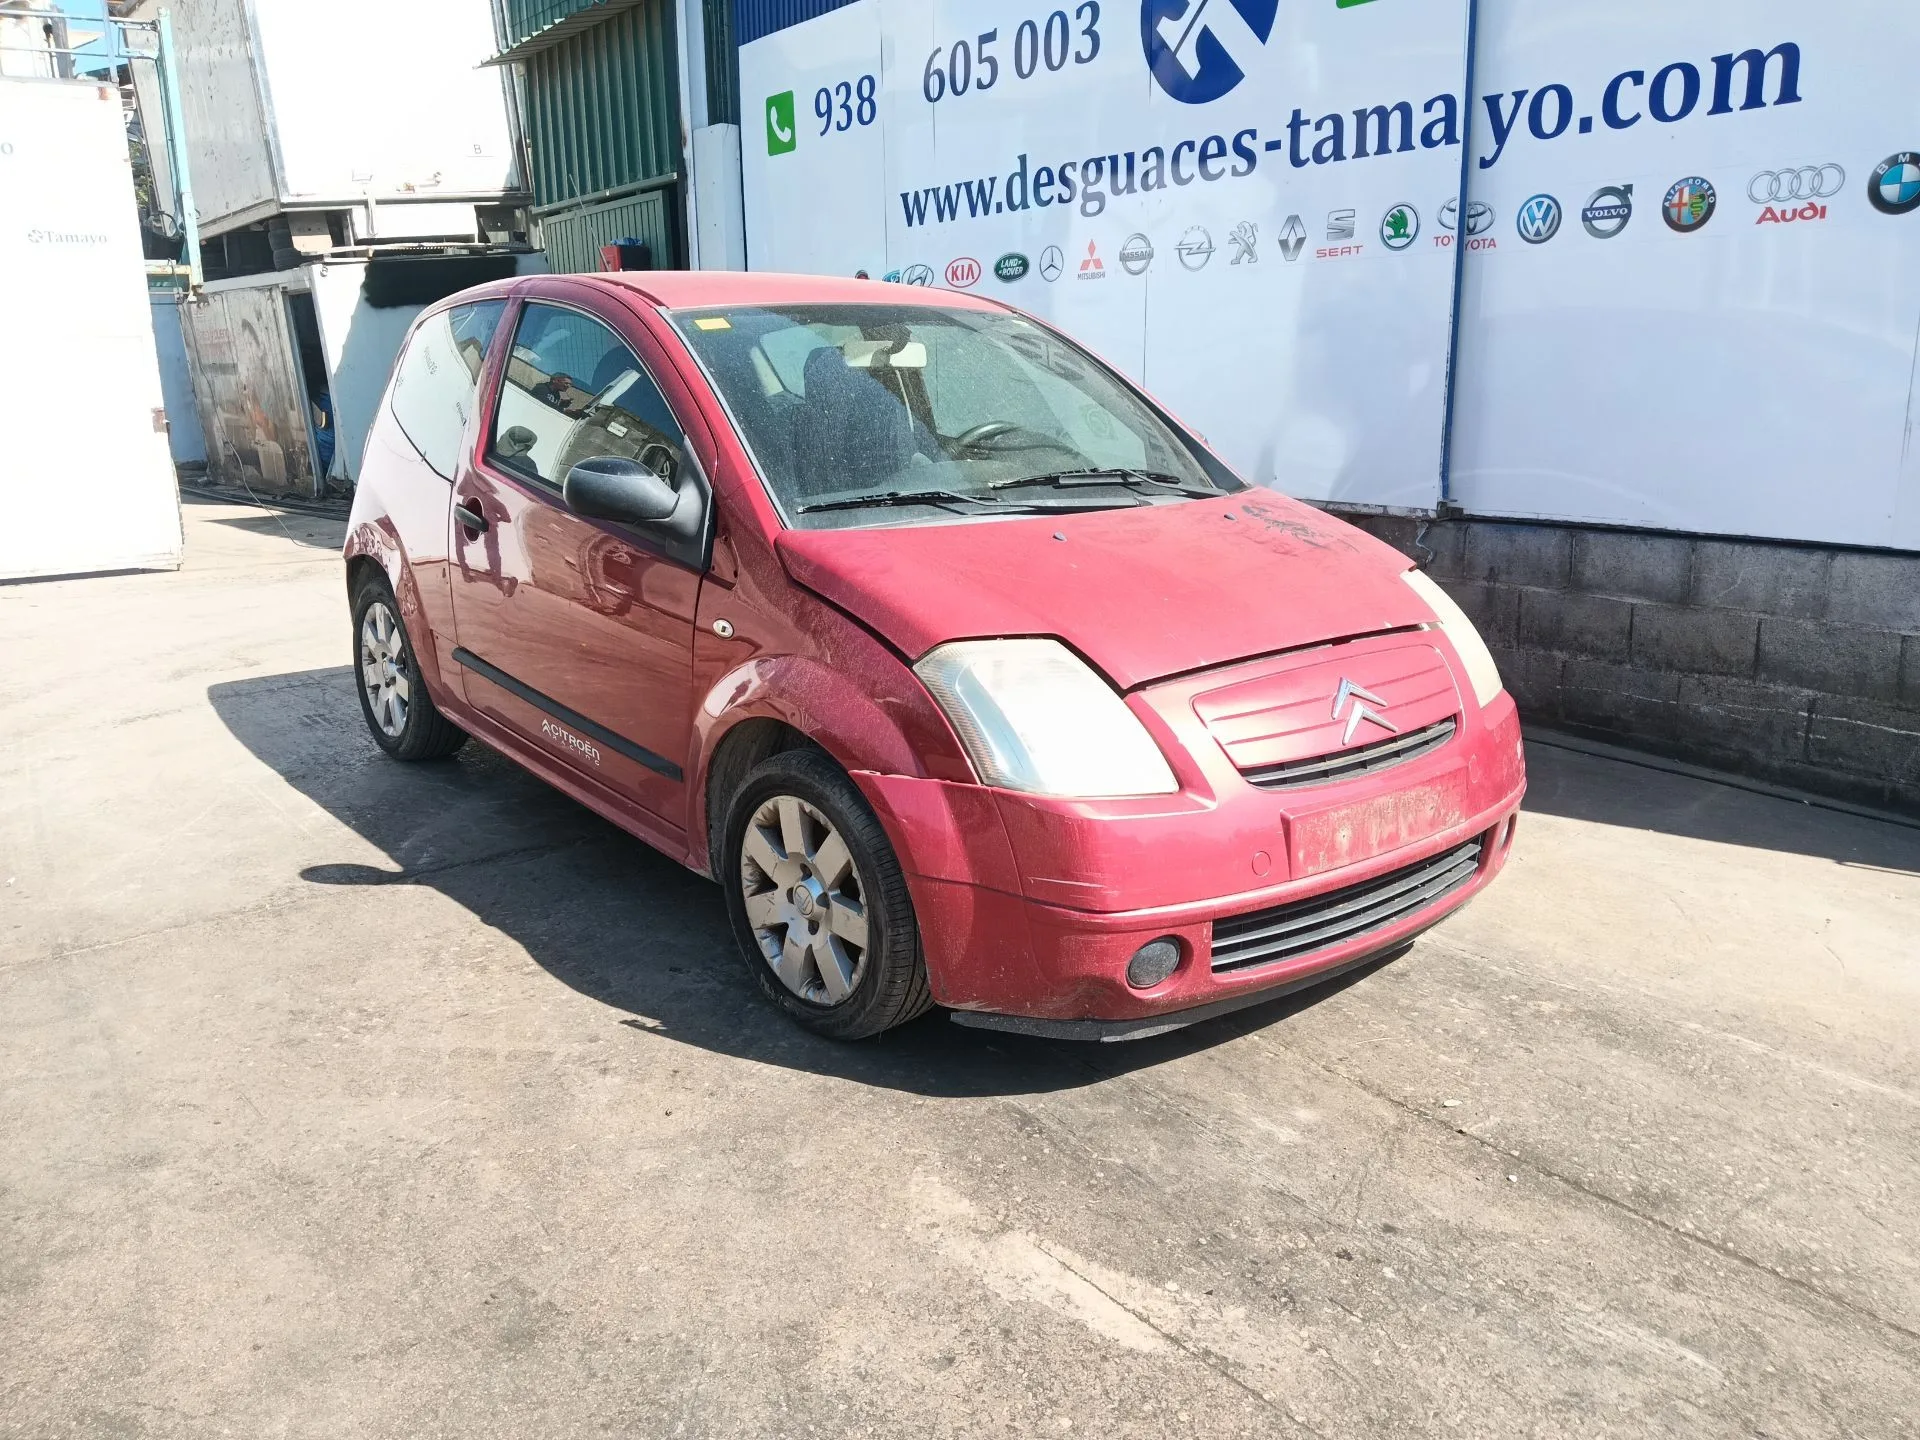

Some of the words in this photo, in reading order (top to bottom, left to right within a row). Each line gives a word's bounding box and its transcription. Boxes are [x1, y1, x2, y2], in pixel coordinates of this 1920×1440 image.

[814, 74, 877, 136] 938
[923, 27, 999, 103] 605
[1014, 0, 1101, 80] 003
[900, 40, 1802, 228] www.desguaces-tamayo.com
[1586, 207, 1628, 218] VOLVO
[1755, 202, 1827, 224] Audi
[1122, 251, 1151, 260] NISSAN
[1316, 245, 1363, 258] SEAT
[951, 264, 975, 282] KIA
[1077, 272, 1106, 280] MITSUBISHI
